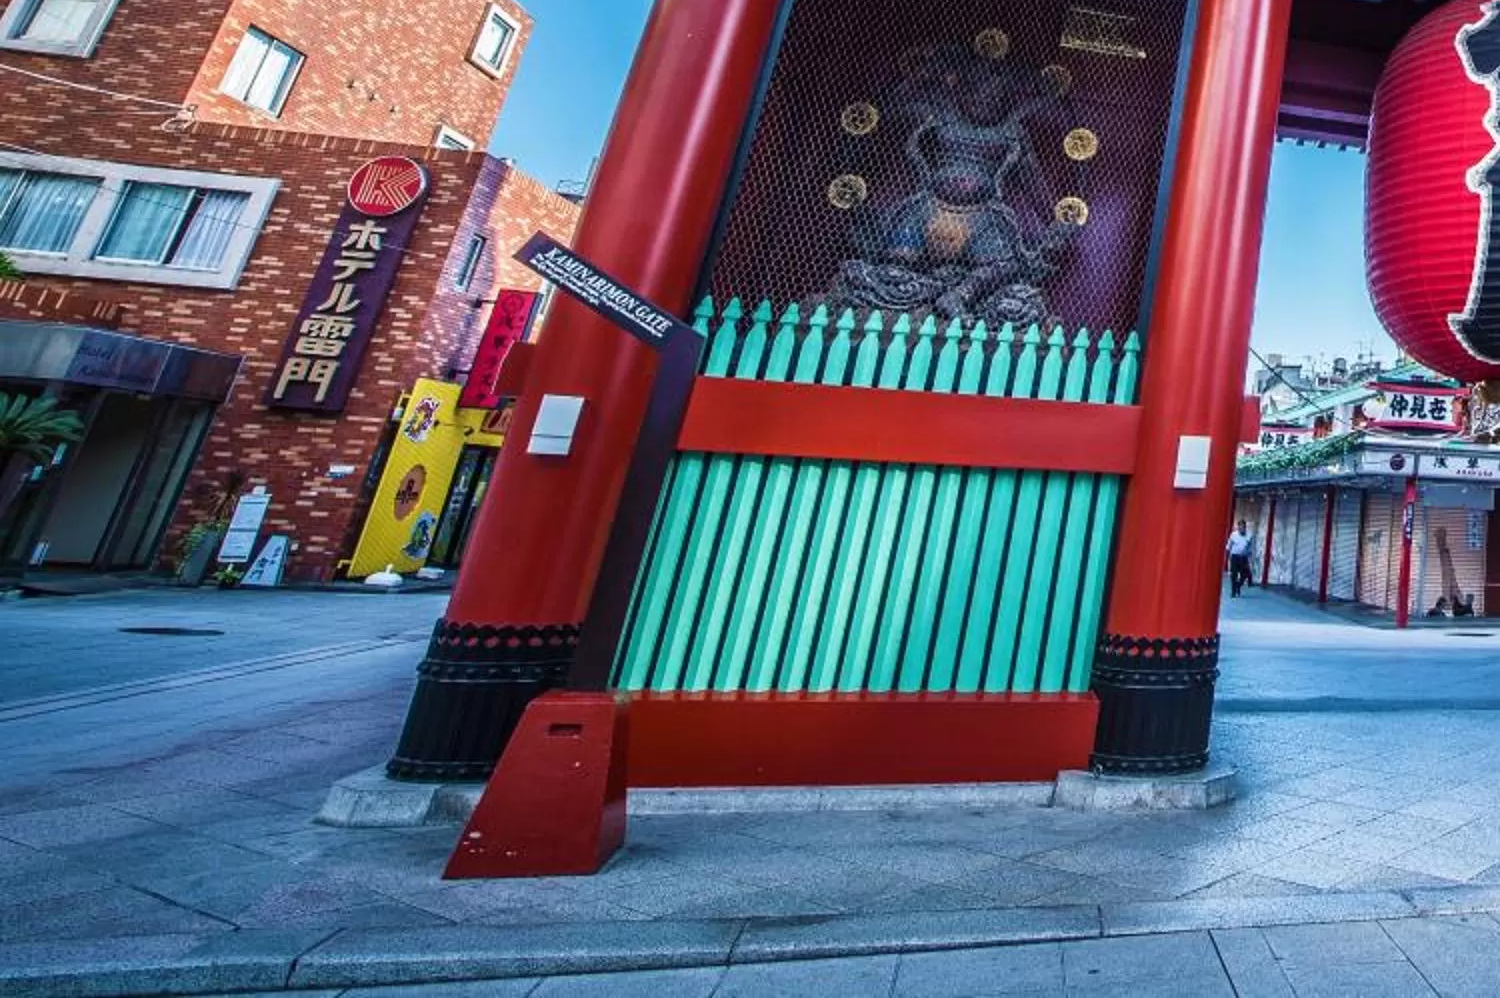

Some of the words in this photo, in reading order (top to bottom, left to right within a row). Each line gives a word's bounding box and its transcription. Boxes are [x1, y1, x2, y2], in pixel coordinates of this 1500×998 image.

[273, 221, 385, 402] ホテル雷門
[545, 247, 640, 311] KAMINARIMON
[635, 304, 673, 333] GATE
[1389, 394, 1447, 421] 仲見世
